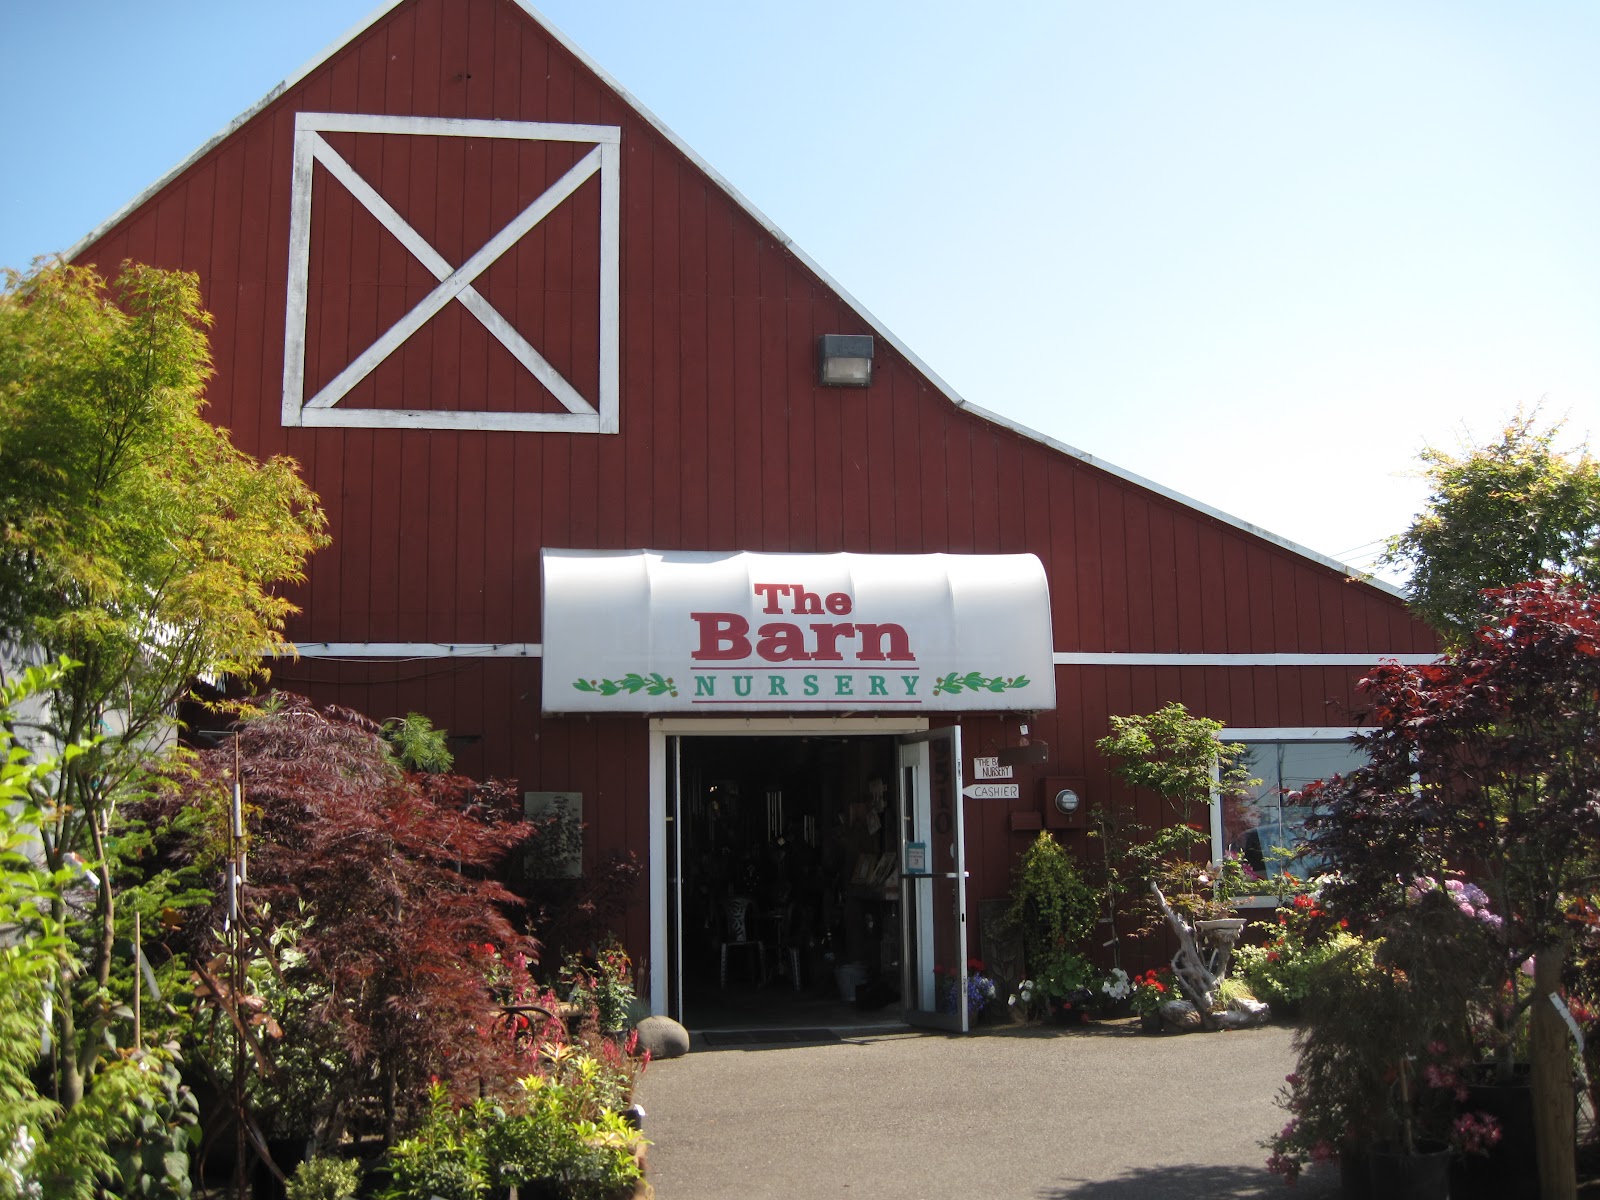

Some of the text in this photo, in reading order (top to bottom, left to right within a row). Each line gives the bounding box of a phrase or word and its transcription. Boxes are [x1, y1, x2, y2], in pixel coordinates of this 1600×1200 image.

[754, 583, 852, 615] The
[690, 611, 916, 662] Barn
[694, 674, 920, 697] NURSERY
[977, 758, 990, 766] THE
[974, 786, 1017, 797] CASHIER
